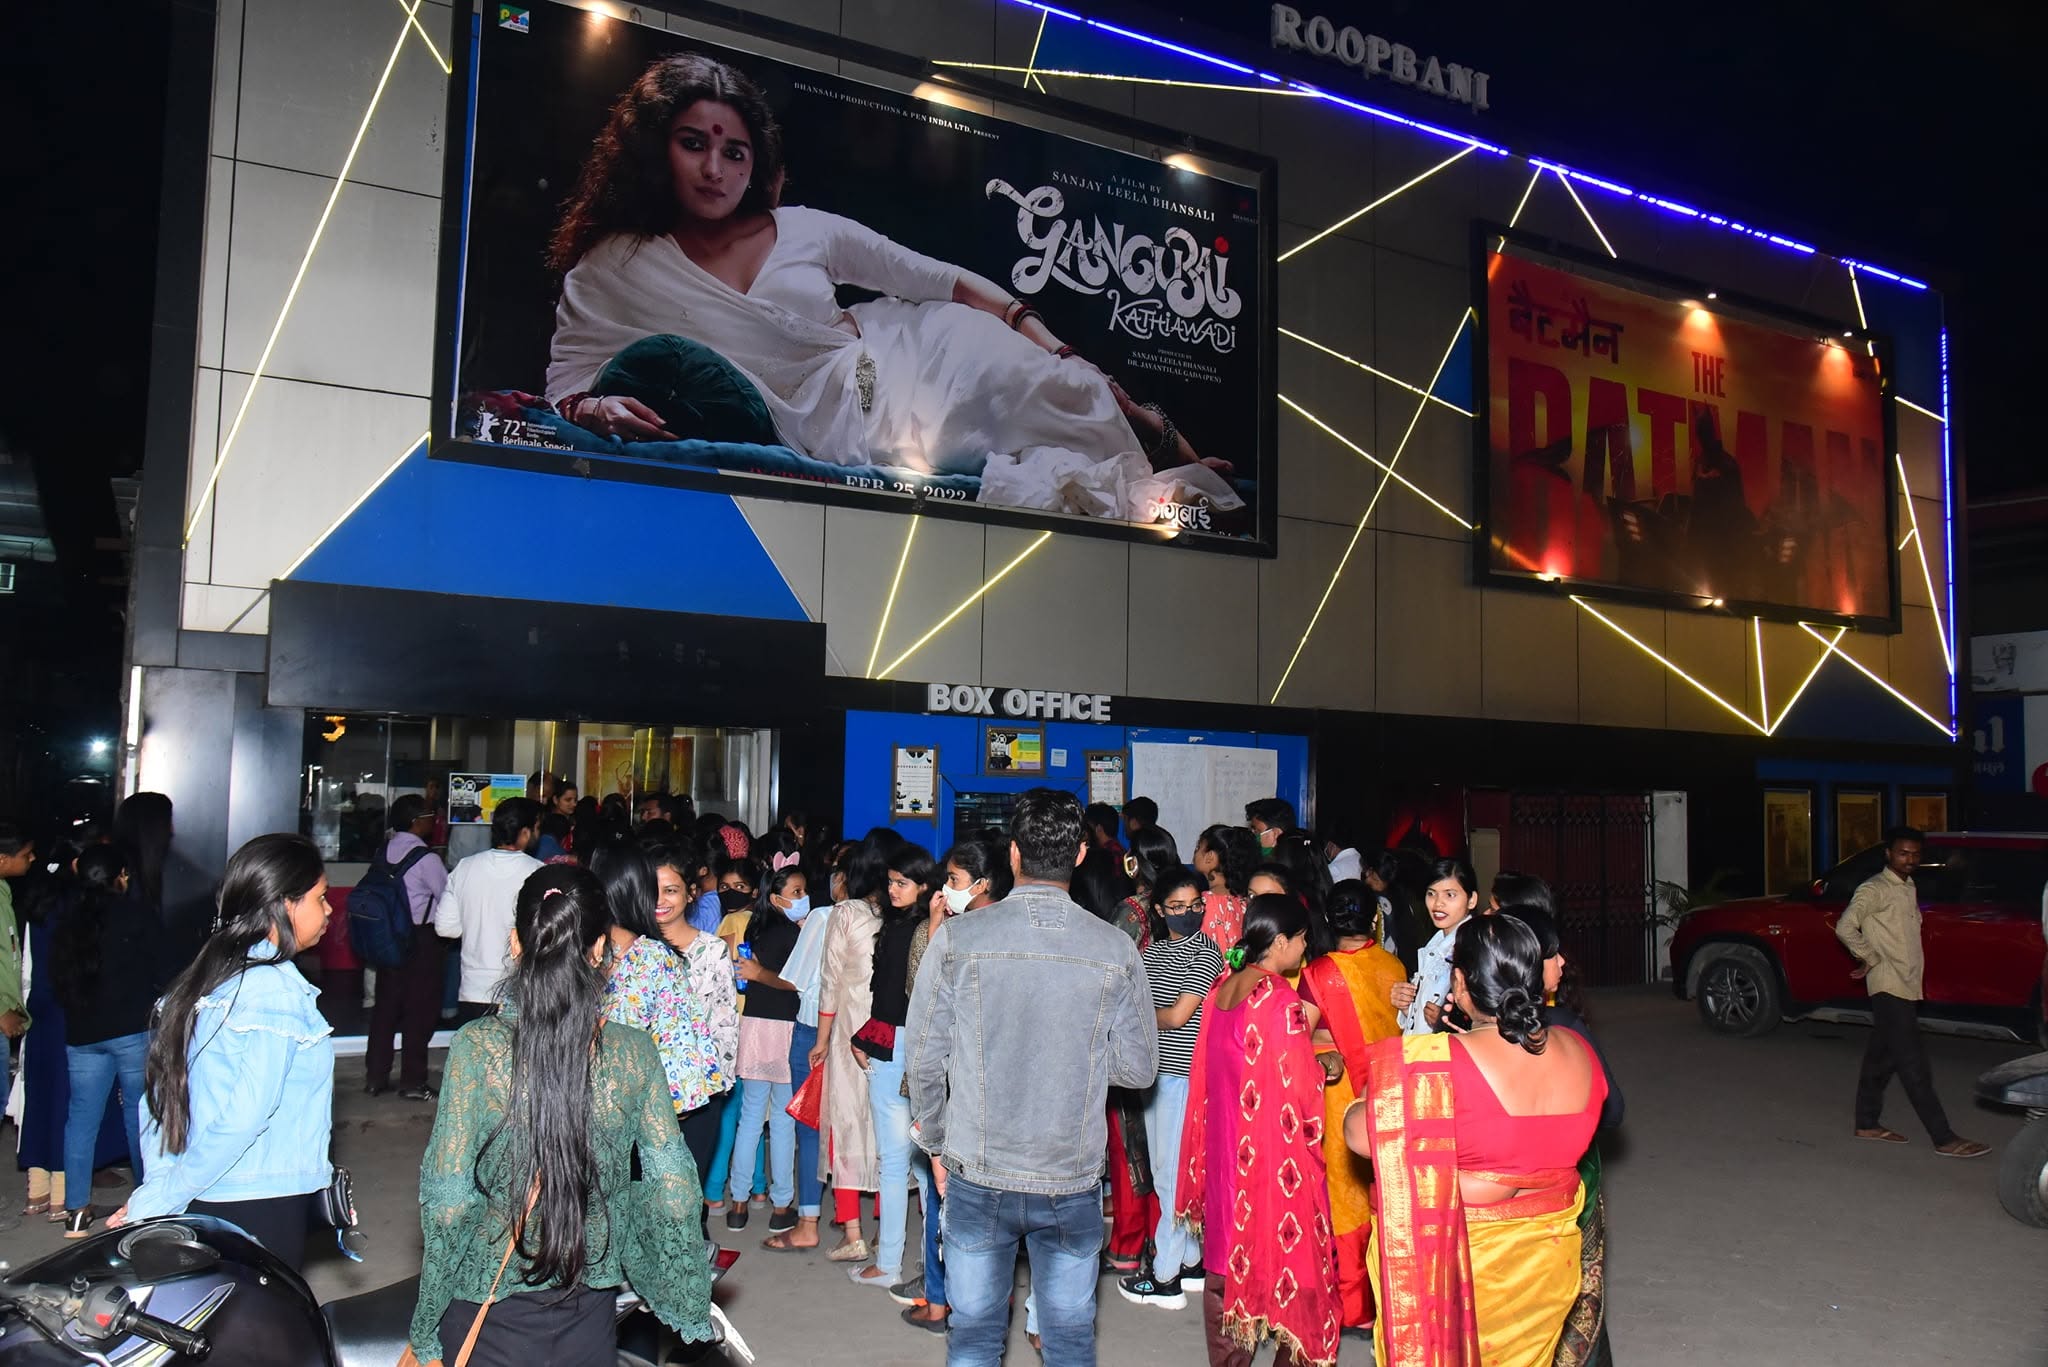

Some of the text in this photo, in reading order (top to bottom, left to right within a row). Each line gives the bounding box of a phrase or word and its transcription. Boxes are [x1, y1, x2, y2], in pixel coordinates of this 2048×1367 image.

[1271, 3, 1490, 111] ROOPBANI
[794, 81, 838, 99] BHANSALI
[840, 93, 901, 115] PRODUCTIONS
[910, 111, 927, 122] PEN
[929, 116, 953, 128] INDIA
[954, 122, 972, 134] LTD.
[973, 129, 1000, 140] PRESENT
[1052, 170, 1216, 222] SANJAY LEELA BHANSALI
[1111, 175, 1161, 194] A FILM BY
[1132, 351, 1217, 374] SANJAY LEELA BHANSALI
[1691, 351, 1726, 398] THE
[502, 435, 542, 448] Berlinale
[503, 419, 520, 436] 72
[928, 683, 1112, 721] BOX OFFICE
